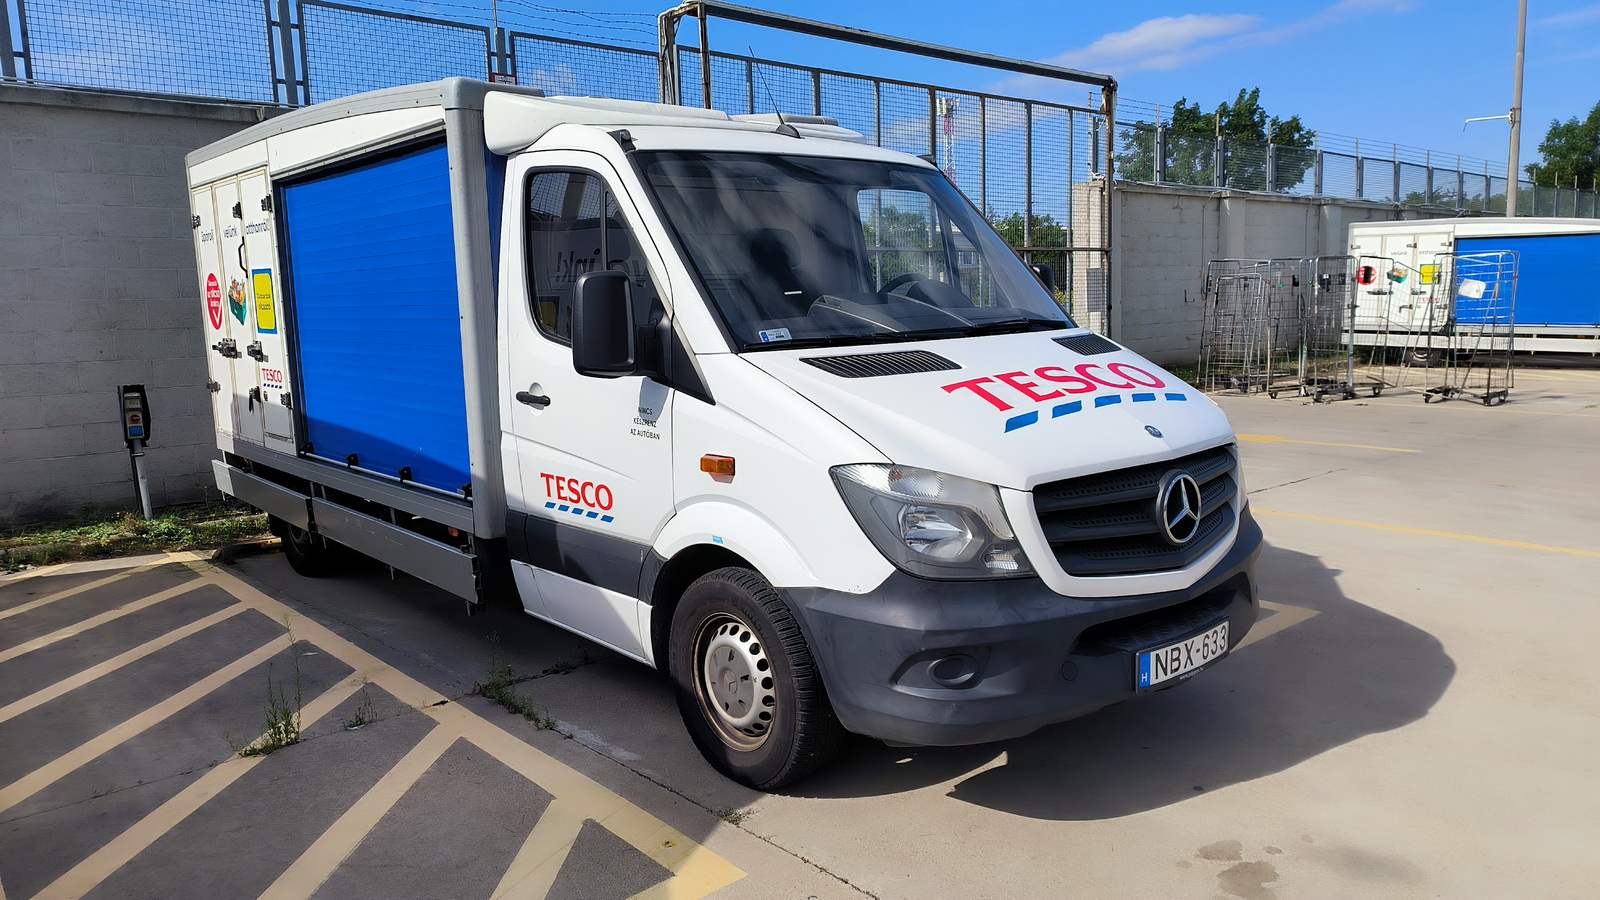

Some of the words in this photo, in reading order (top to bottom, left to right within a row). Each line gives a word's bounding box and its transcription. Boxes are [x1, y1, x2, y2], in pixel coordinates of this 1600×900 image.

[261, 368, 283, 383] TESCO
[941, 363, 1166, 412] TESCO
[638, 406, 653, 415] NINCS
[633, 415, 657, 428] KÉSZPÉNZ
[630, 428, 636, 436] AZ
[637, 429, 660, 440] AUTÓBAN
[540, 472, 614, 511] TESCO
[1141, 672, 1148, 683] H
[1155, 625, 1227, 680] NBX-633
